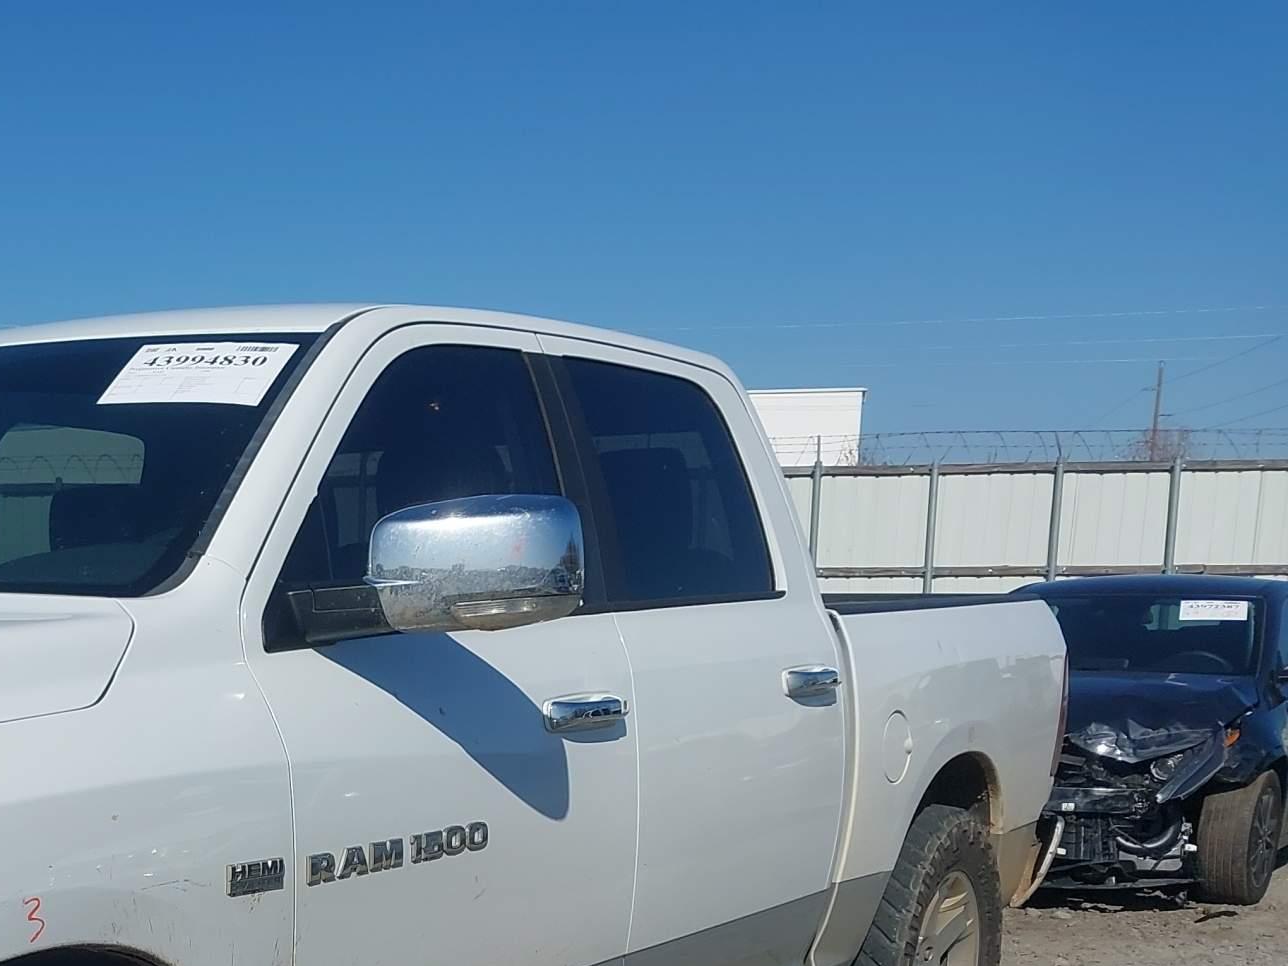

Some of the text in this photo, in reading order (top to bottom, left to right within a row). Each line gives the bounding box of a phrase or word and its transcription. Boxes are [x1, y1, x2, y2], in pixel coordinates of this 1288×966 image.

[143, 355, 268, 367] 43994830
[229, 858, 285, 882] HEMI
[305, 820, 489, 887] RAM 1500
[23, 896, 46, 943] 3
